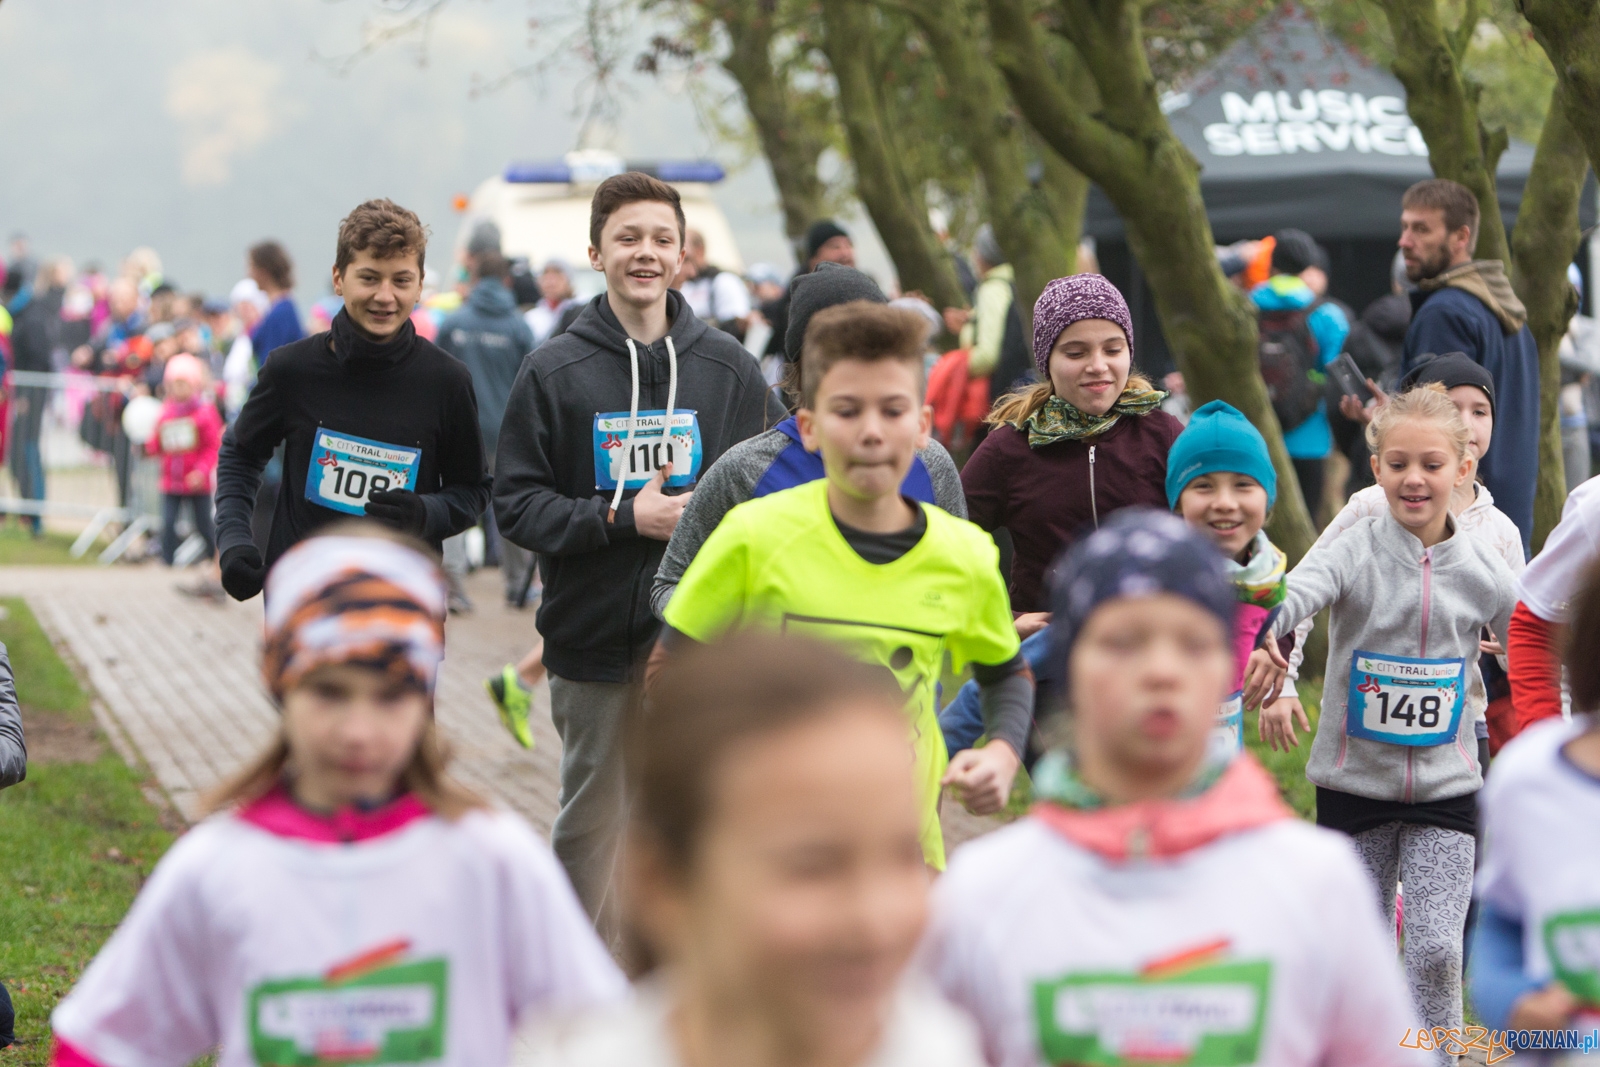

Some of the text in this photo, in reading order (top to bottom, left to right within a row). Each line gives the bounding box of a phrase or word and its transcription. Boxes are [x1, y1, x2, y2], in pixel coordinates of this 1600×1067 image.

[1220, 88, 1412, 126] MUSIC
[383, 451, 410, 462] Junior
[624, 442, 674, 473] 110
[333, 466, 391, 499] 108
[1431, 666, 1456, 676] Junior
[1376, 691, 1441, 728] 148
